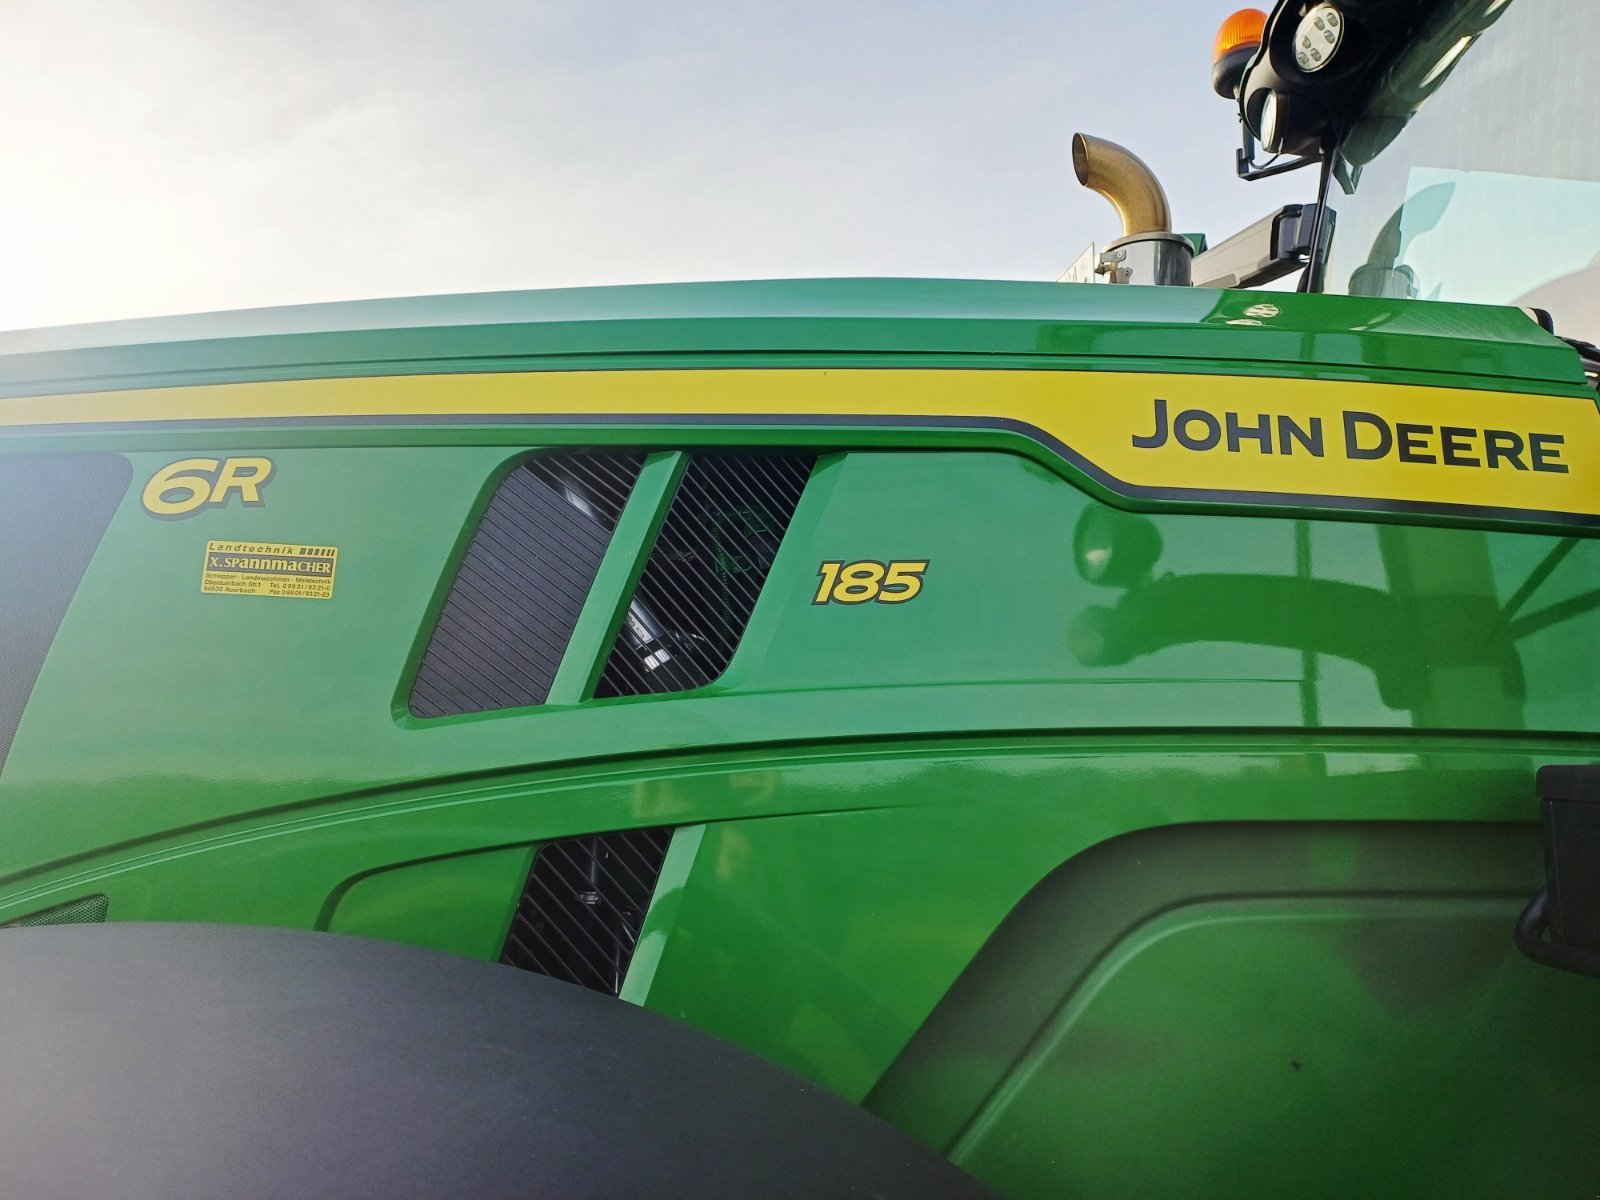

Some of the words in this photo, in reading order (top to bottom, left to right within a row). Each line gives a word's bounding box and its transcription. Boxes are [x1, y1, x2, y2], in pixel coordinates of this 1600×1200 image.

[1132, 399, 1325, 458] JOHN
[1342, 410, 1570, 474] DEERE
[142, 456, 277, 521] 6R
[208, 542, 294, 555] Landtechnik
[241, 574, 290, 583] Landmaschinen
[811, 559, 930, 605] 185
